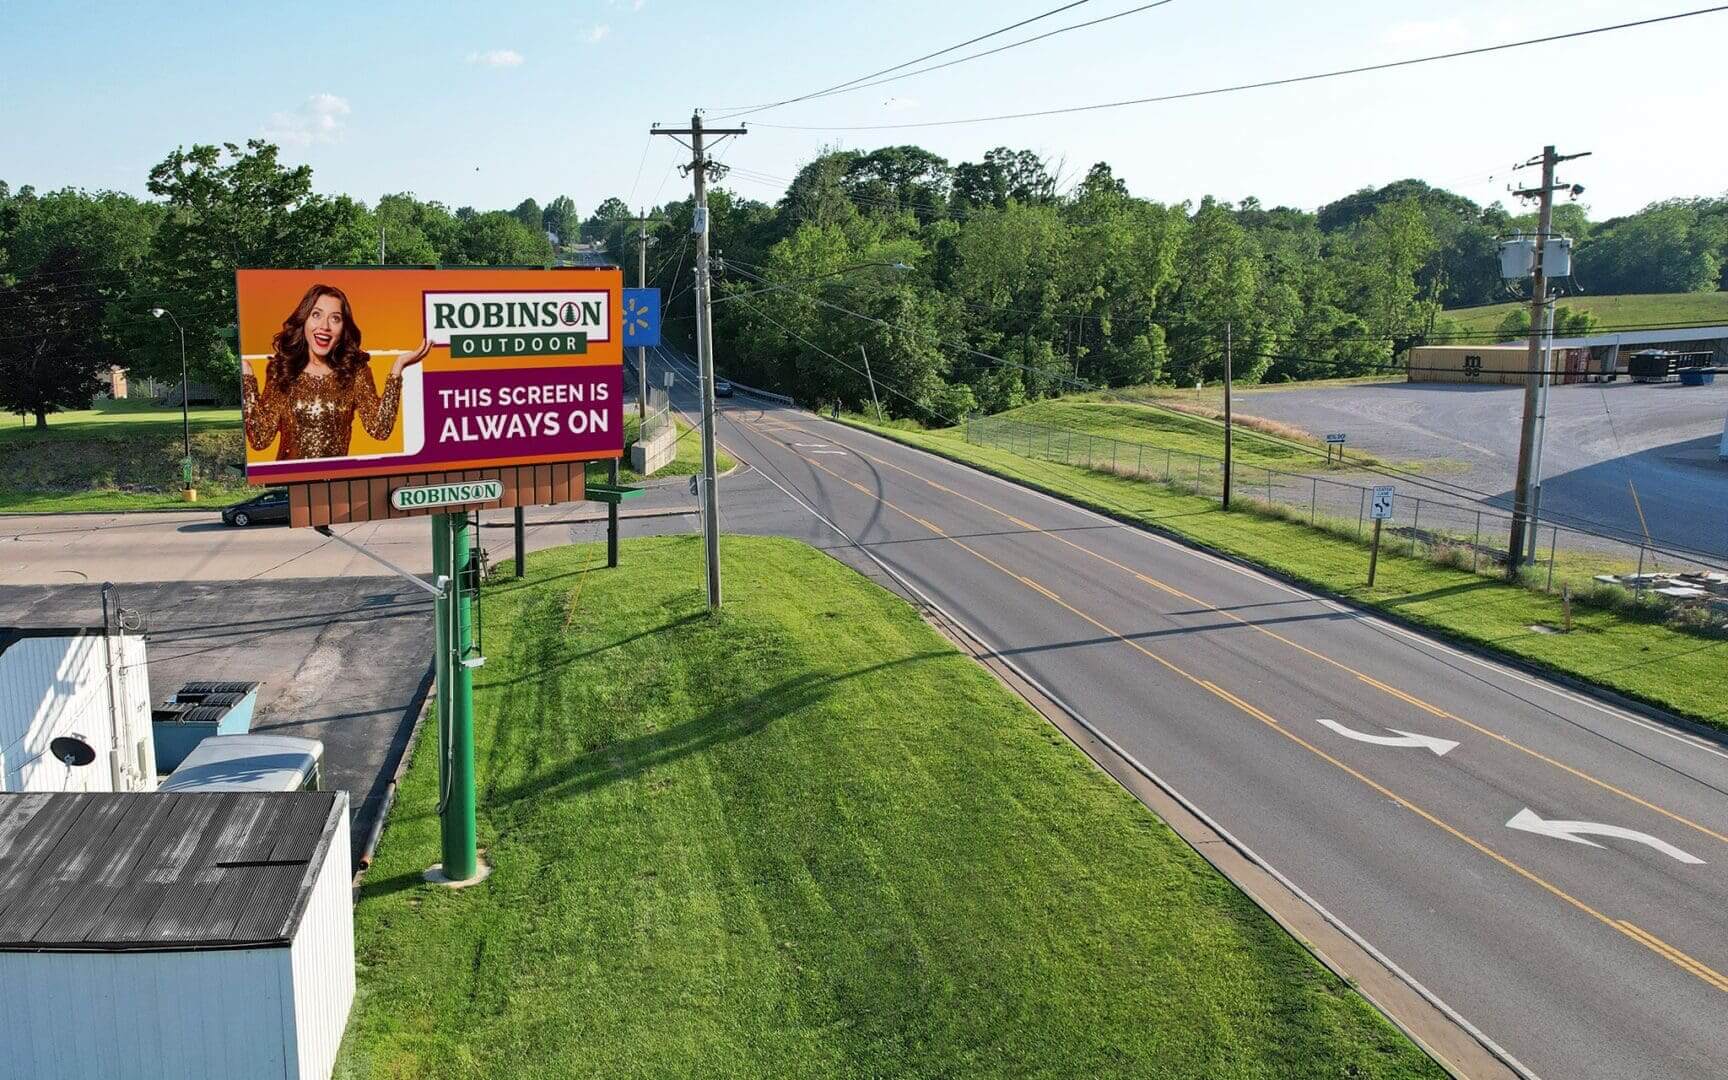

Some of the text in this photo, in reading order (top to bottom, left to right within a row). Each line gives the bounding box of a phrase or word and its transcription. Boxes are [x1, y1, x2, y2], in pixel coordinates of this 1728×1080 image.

[433, 301, 602, 329] ROBINSON
[462, 336, 576, 354] OUTDOOR
[438, 383, 609, 409] THIS SCREEN IS
[439, 408, 609, 443] ALWAYS ON
[400, 483, 497, 506] ROBINSON
